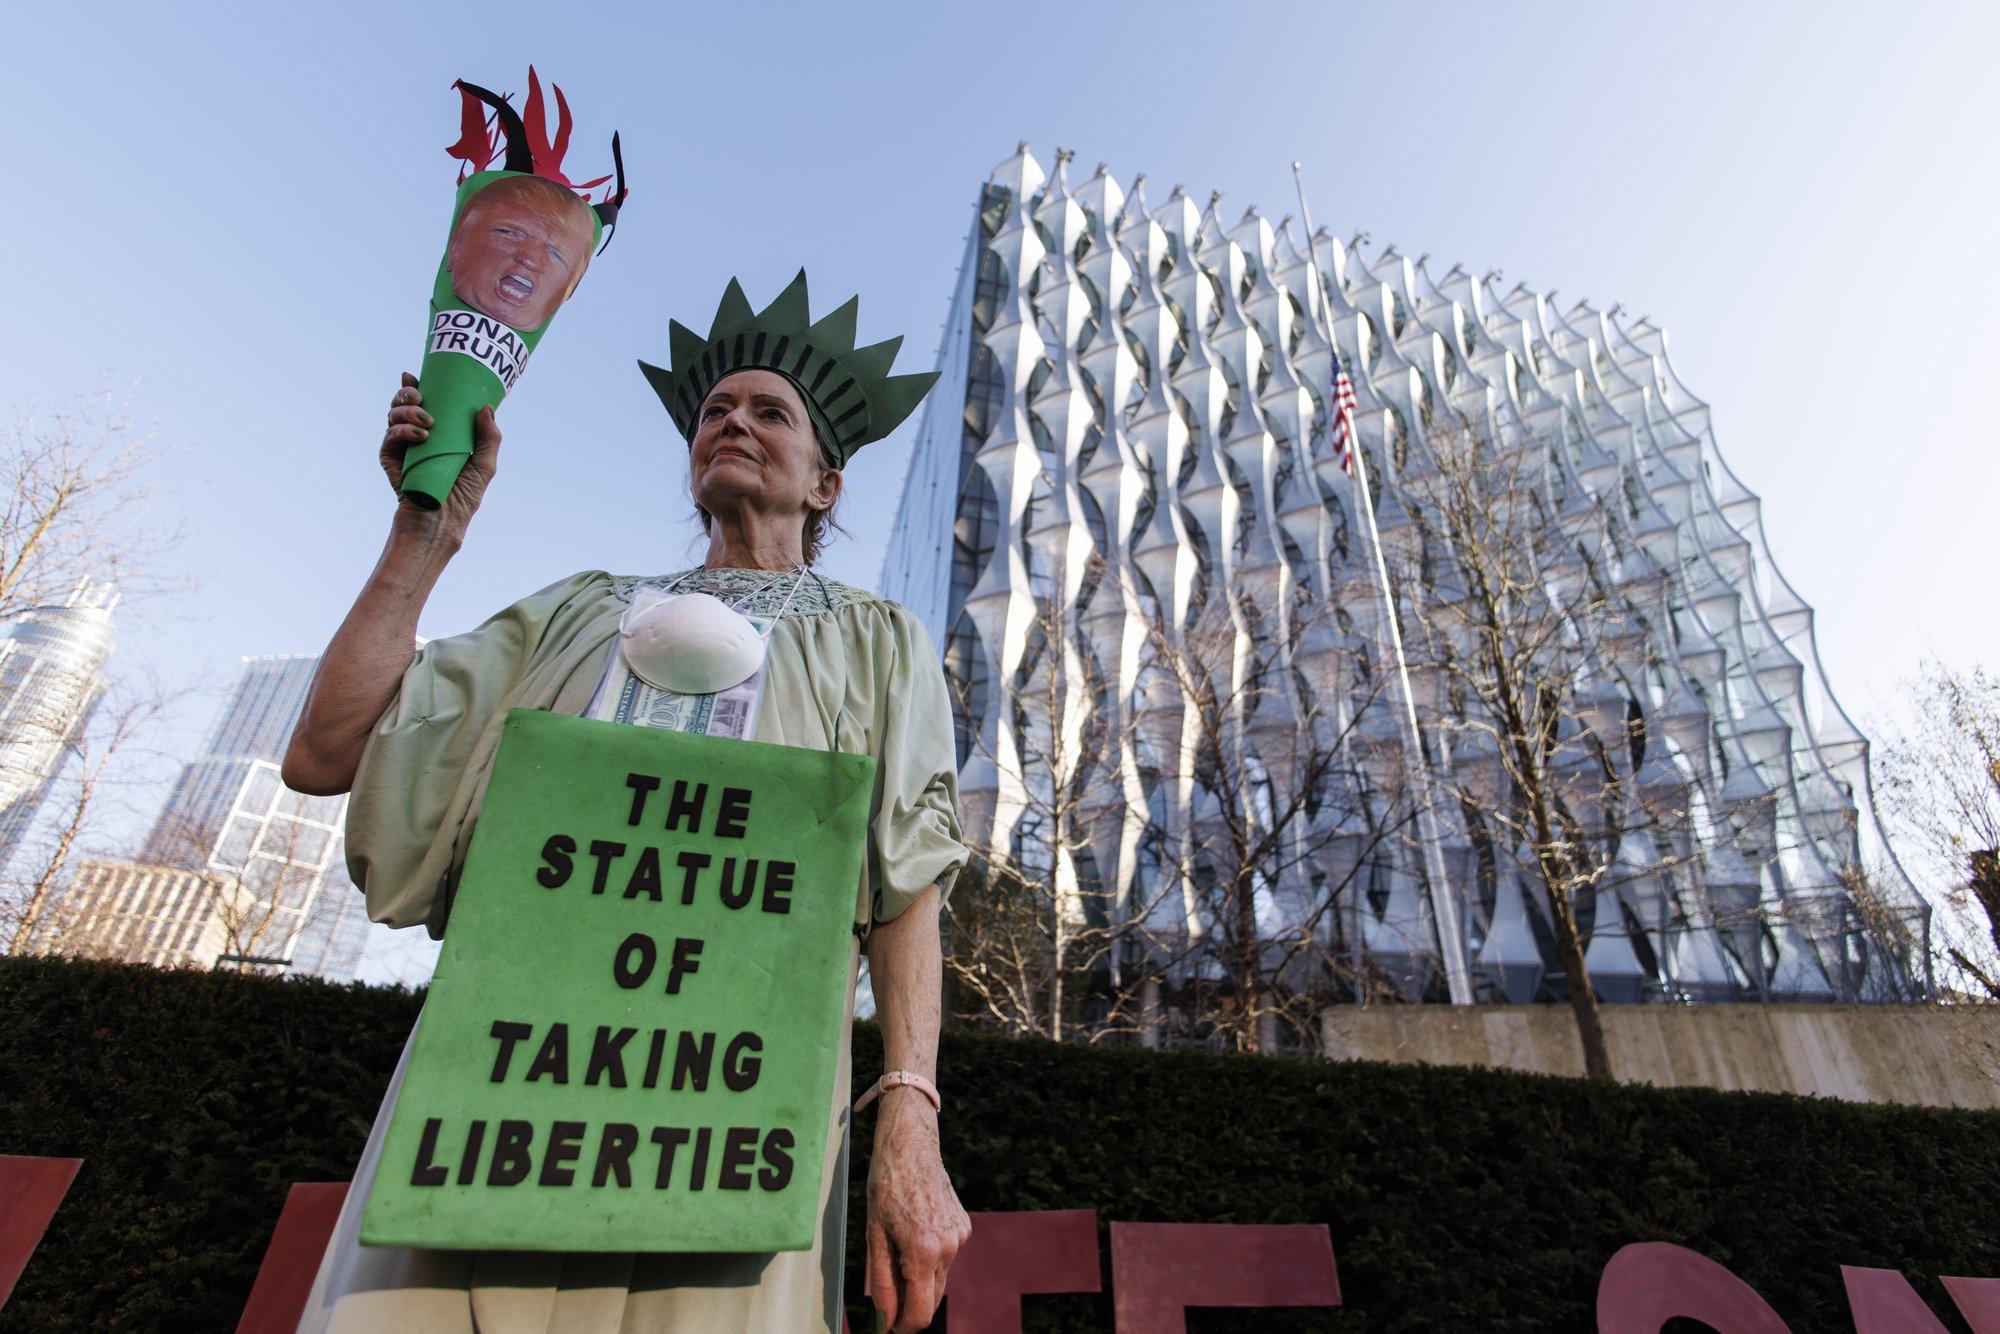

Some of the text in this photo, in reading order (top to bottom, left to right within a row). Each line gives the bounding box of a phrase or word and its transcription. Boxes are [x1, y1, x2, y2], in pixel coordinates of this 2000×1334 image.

[433, 313, 528, 375] DONALD
[646, 688, 685, 729] ON
[624, 772, 754, 840] THE
[535, 833, 797, 916] STATUE
[612, 932, 705, 996] OF
[488, 1019, 764, 1093] TAKING
[409, 1117, 796, 1193] LIBERTIES
